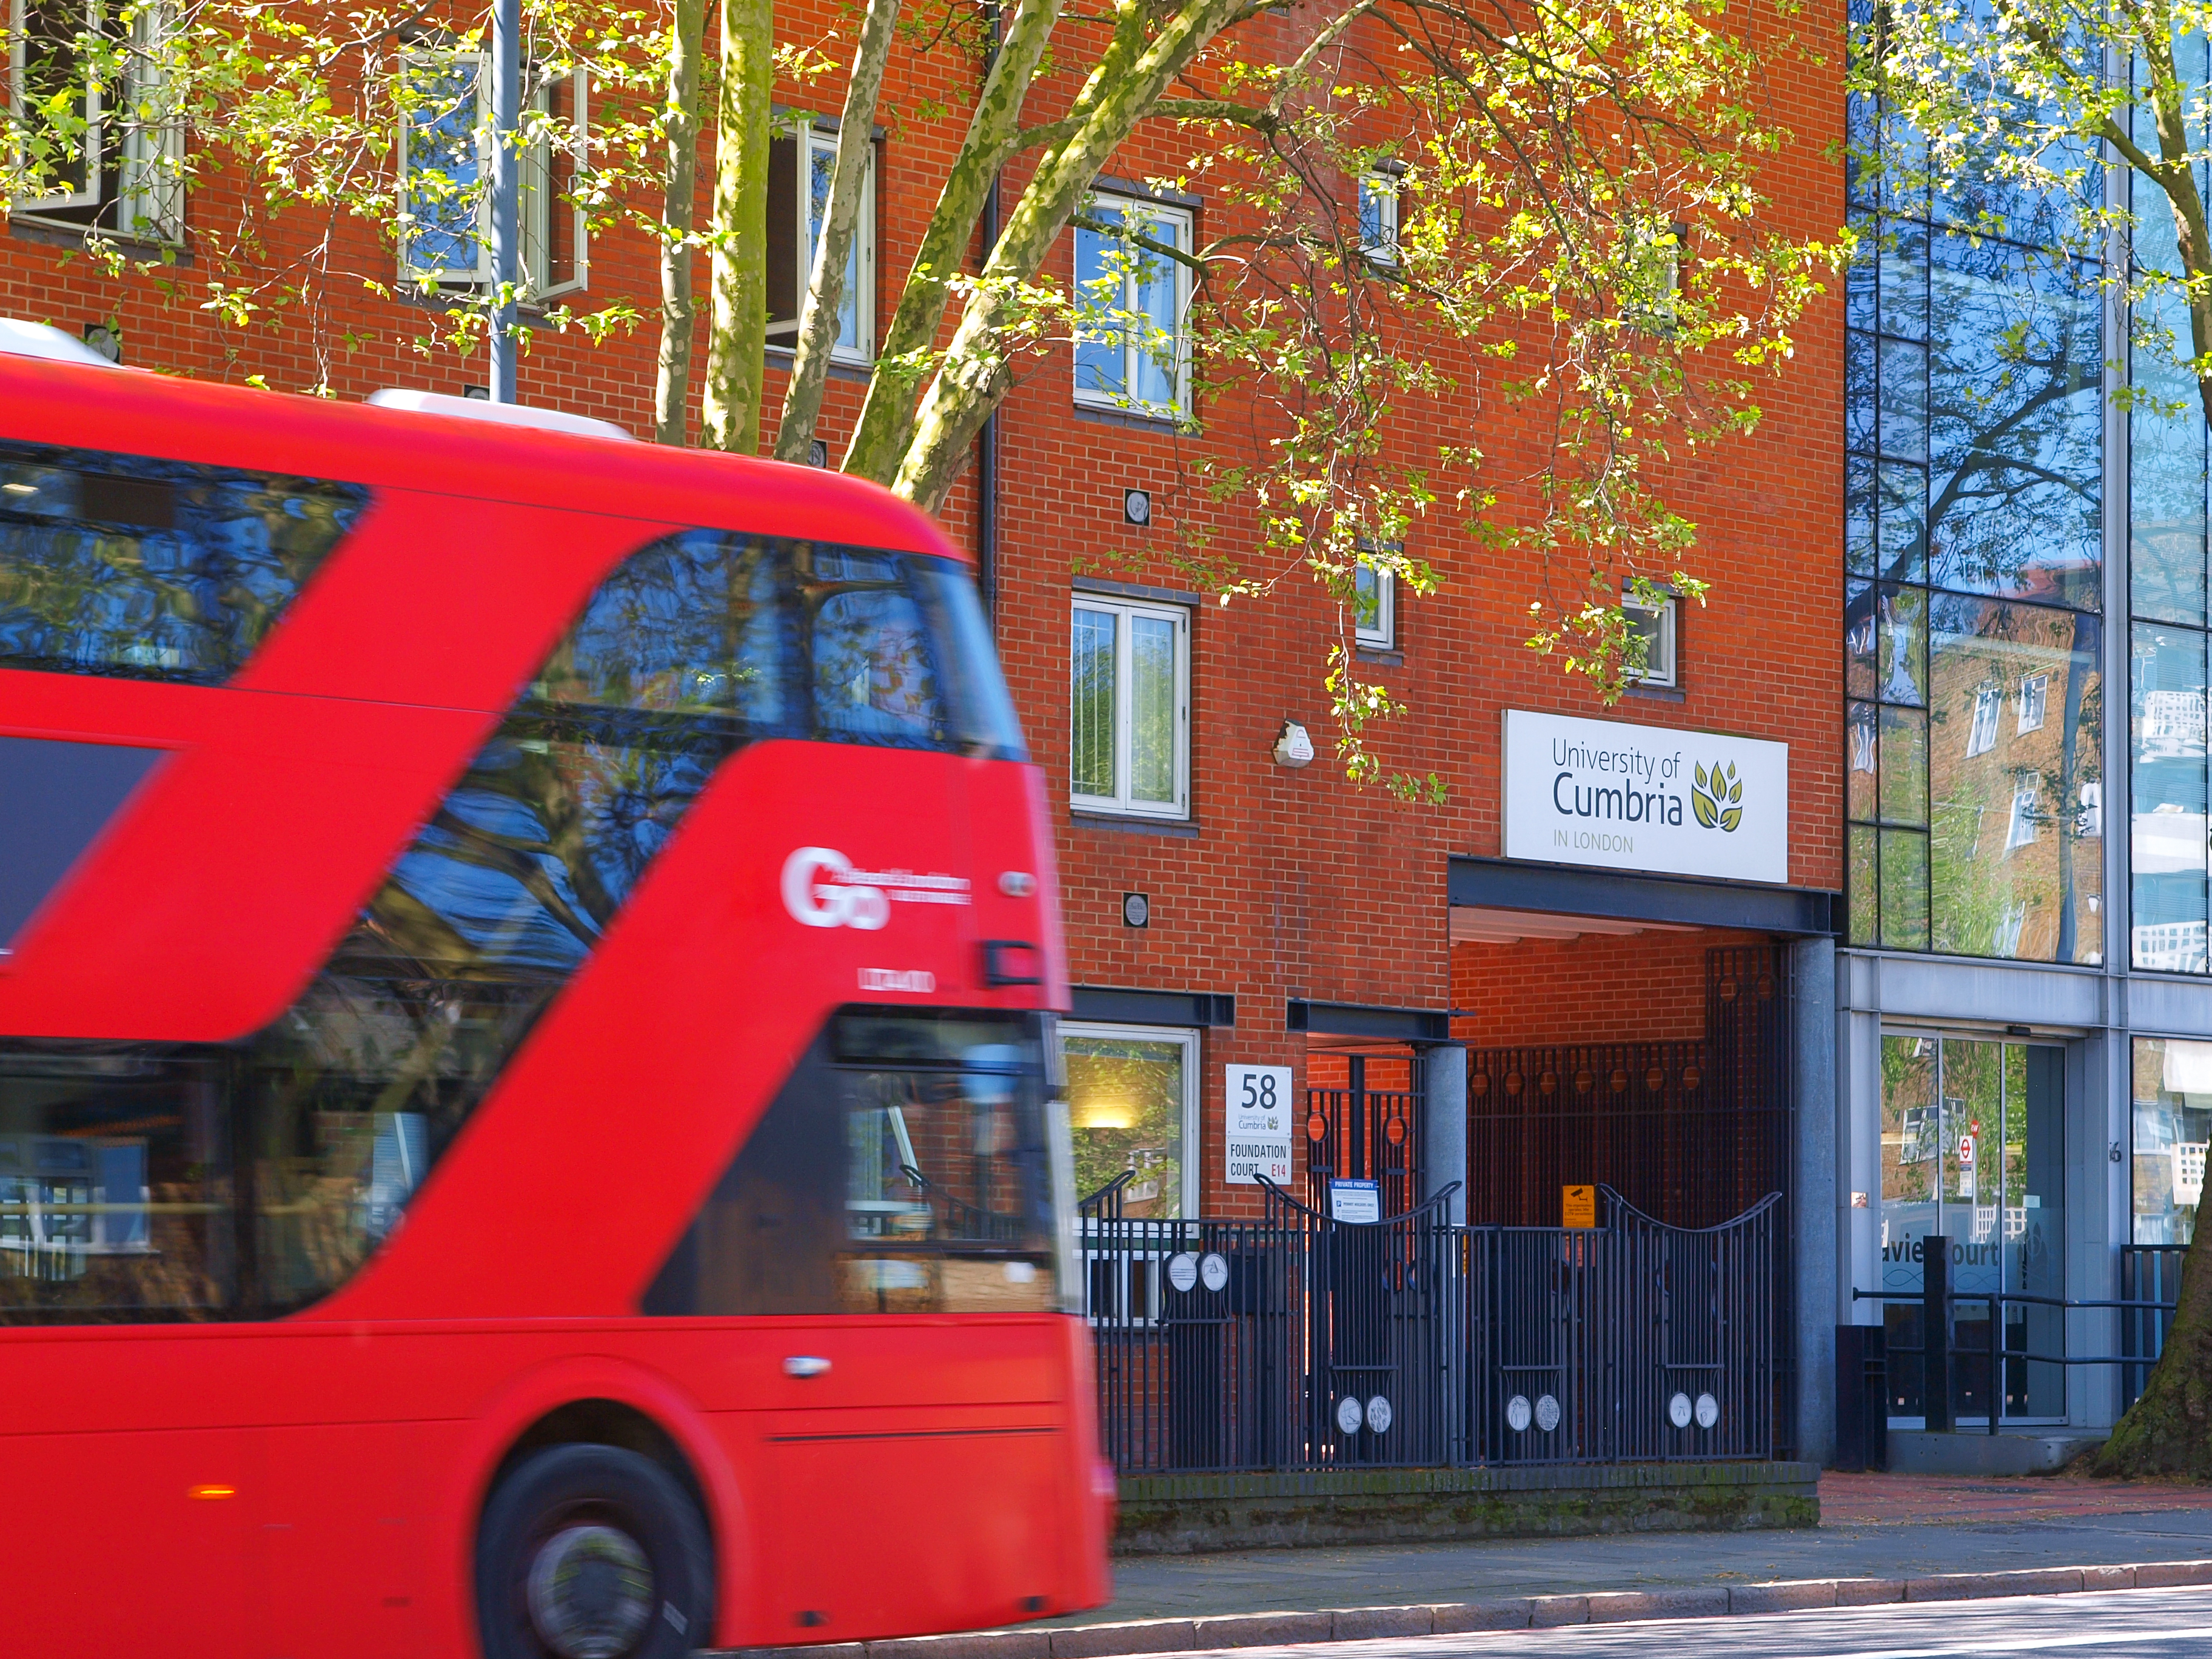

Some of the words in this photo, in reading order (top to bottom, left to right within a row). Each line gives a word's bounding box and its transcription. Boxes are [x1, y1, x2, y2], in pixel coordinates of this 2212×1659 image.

[1553, 737, 1655, 784] University
[1661, 751, 1681, 779] of
[1553, 772, 1683, 826] Cumbria
[1553, 829, 1568, 847] IN
[1575, 831, 1634, 854] LONDON
[1241, 1074, 1277, 1109] 58
[1239, 1121, 1266, 1130] Cumbria
[1230, 1144, 1287, 1159] FOUNDATION
[1230, 1163, 1259, 1176] COURT
[1272, 1164, 1286, 1177] E14
[1953, 1241, 1999, 1266] ourt
